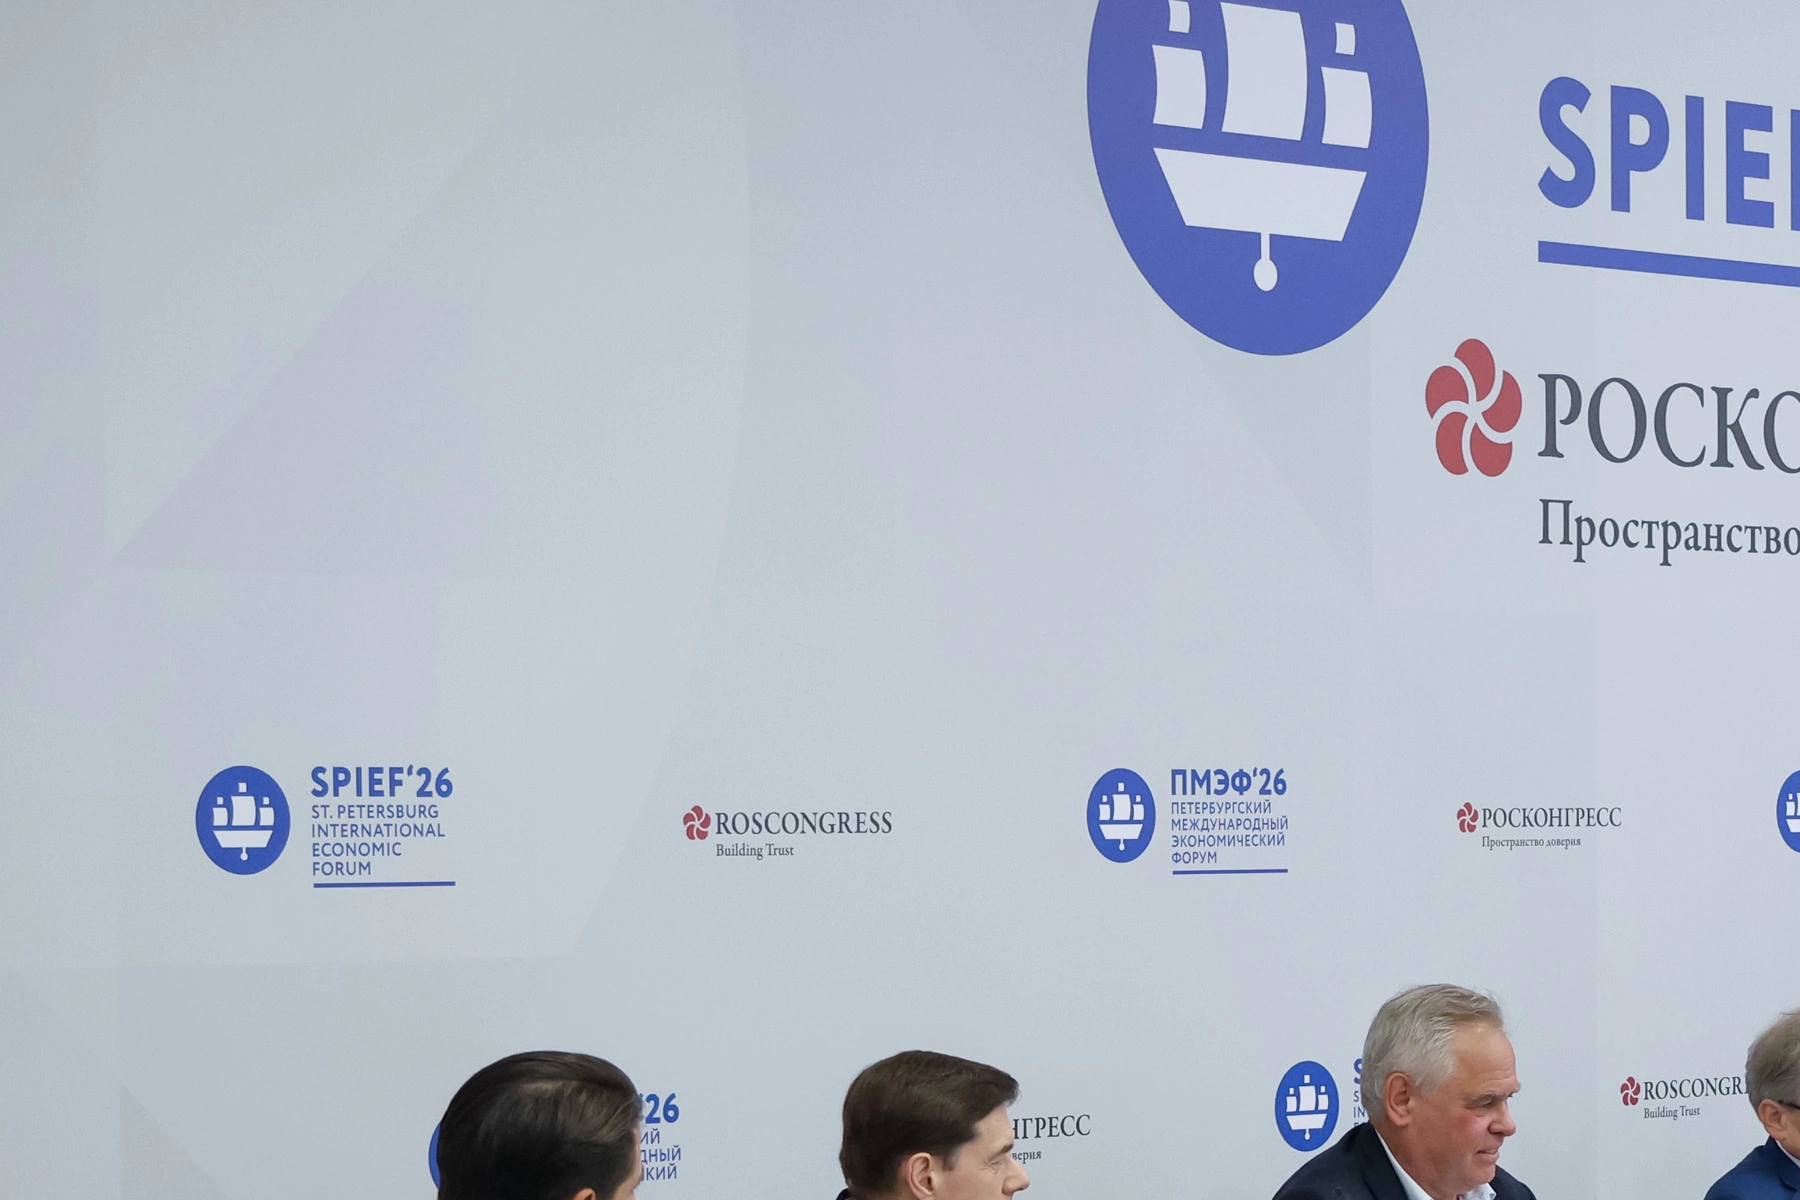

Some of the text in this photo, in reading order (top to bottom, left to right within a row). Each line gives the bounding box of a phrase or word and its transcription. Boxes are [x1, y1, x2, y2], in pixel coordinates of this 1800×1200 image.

[311, 804, 439, 819] ST. PETERSBURG
[1171, 800, 1271, 815] ПЕТЕРБУРГСКИЙ
[715, 811, 892, 836] ROSCONGRESS
[1171, 815, 1288, 832] МЕЖДУНАРОДНЫЙ
[1482, 806, 1622, 828] РОСКОНГРЕСС
[312, 823, 445, 838] INTERNATIONAL
[1171, 832, 1285, 847] ЭКОНОМИЧЕСКИЙ
[1482, 836, 1581, 850] Пространство доверия
[312, 842, 401, 857] ECONOMIC
[716, 843, 794, 860] Building Trust
[1172, 851, 1217, 866] ФОРУМ
[312, 862, 371, 876] FORUM
[1644, 1076, 1748, 1100] ROSCONGR
[1644, 1105, 1700, 1120] Building Trust
[1012, 1114, 1091, 1140] НГРЕСС
[1012, 1151, 1042, 1164] верия
